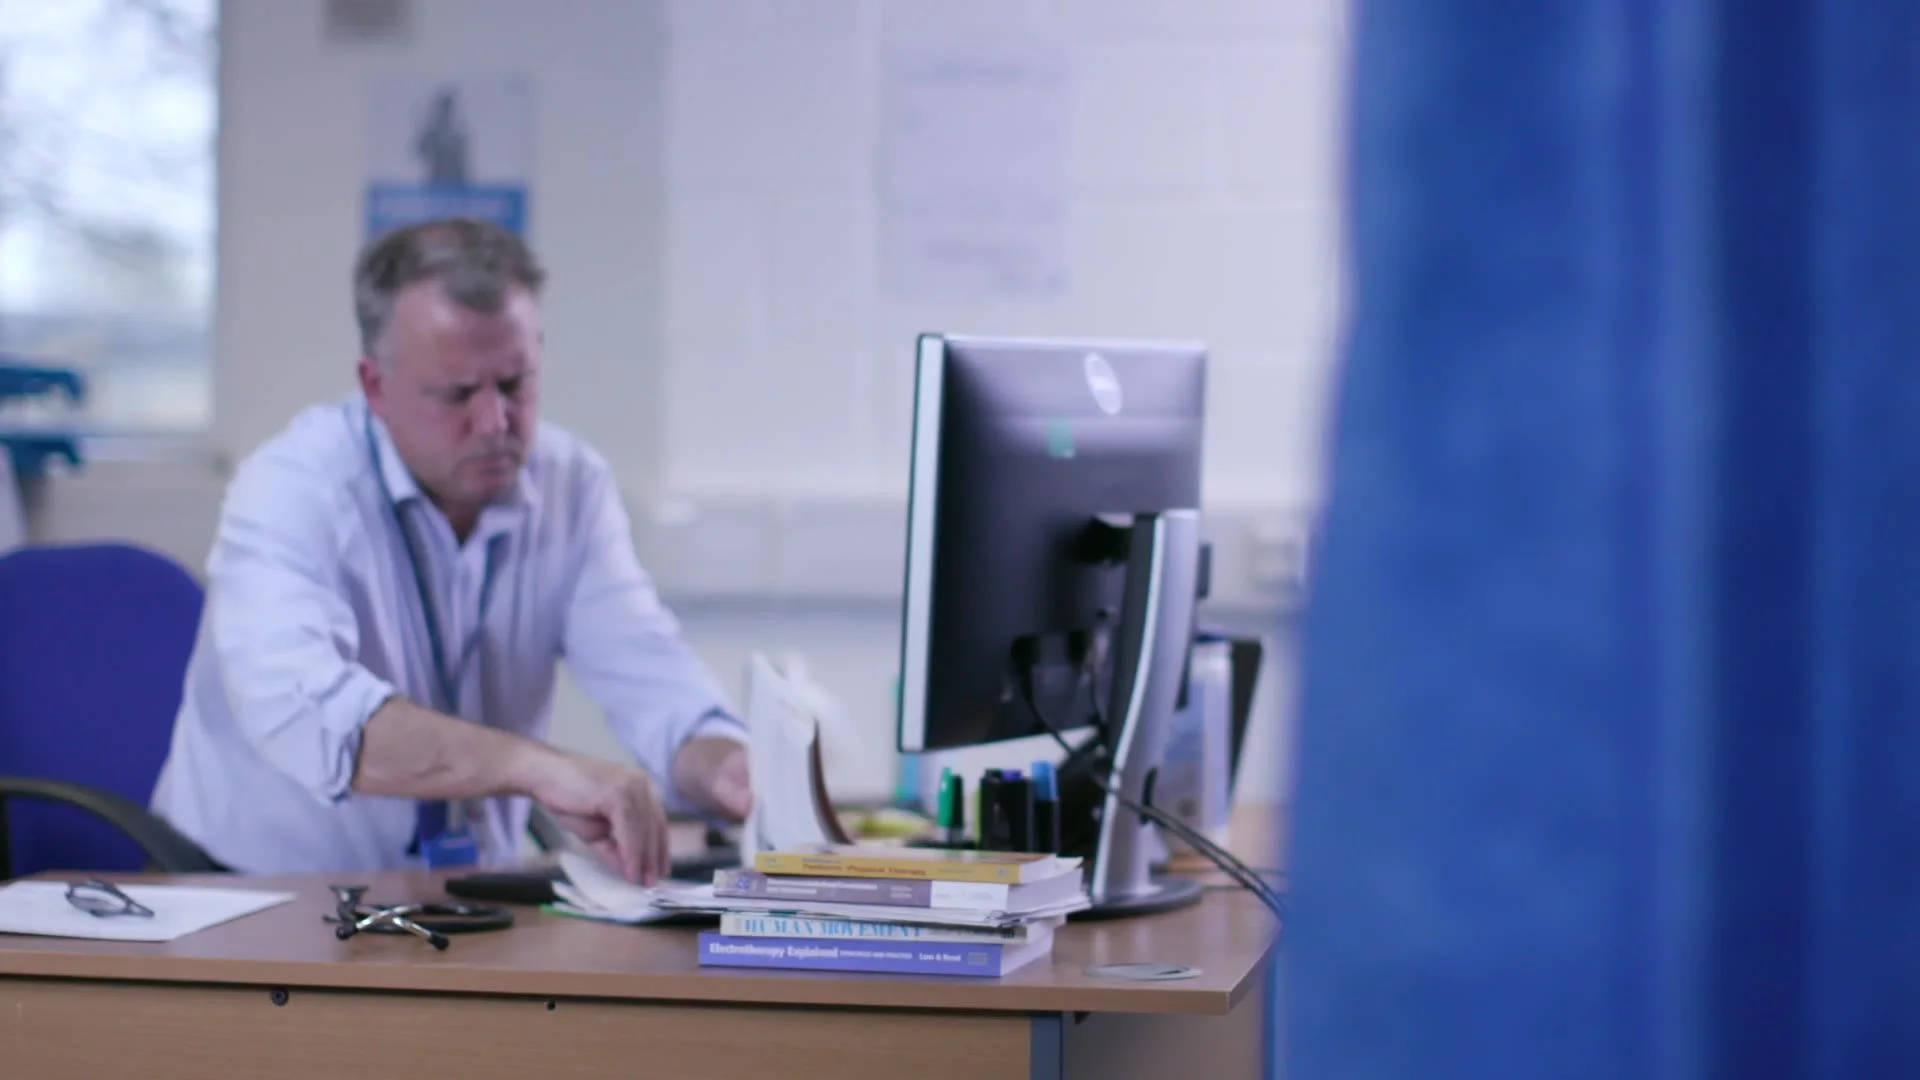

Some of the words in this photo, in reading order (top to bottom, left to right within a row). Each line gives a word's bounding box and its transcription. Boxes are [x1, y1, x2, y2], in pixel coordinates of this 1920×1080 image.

[744, 918, 814, 934] HUMAN
[821, 919, 922, 937] MOVEMENT
[709, 942, 785, 960] Electrotherapy
[786, 944, 839, 961] Explained
